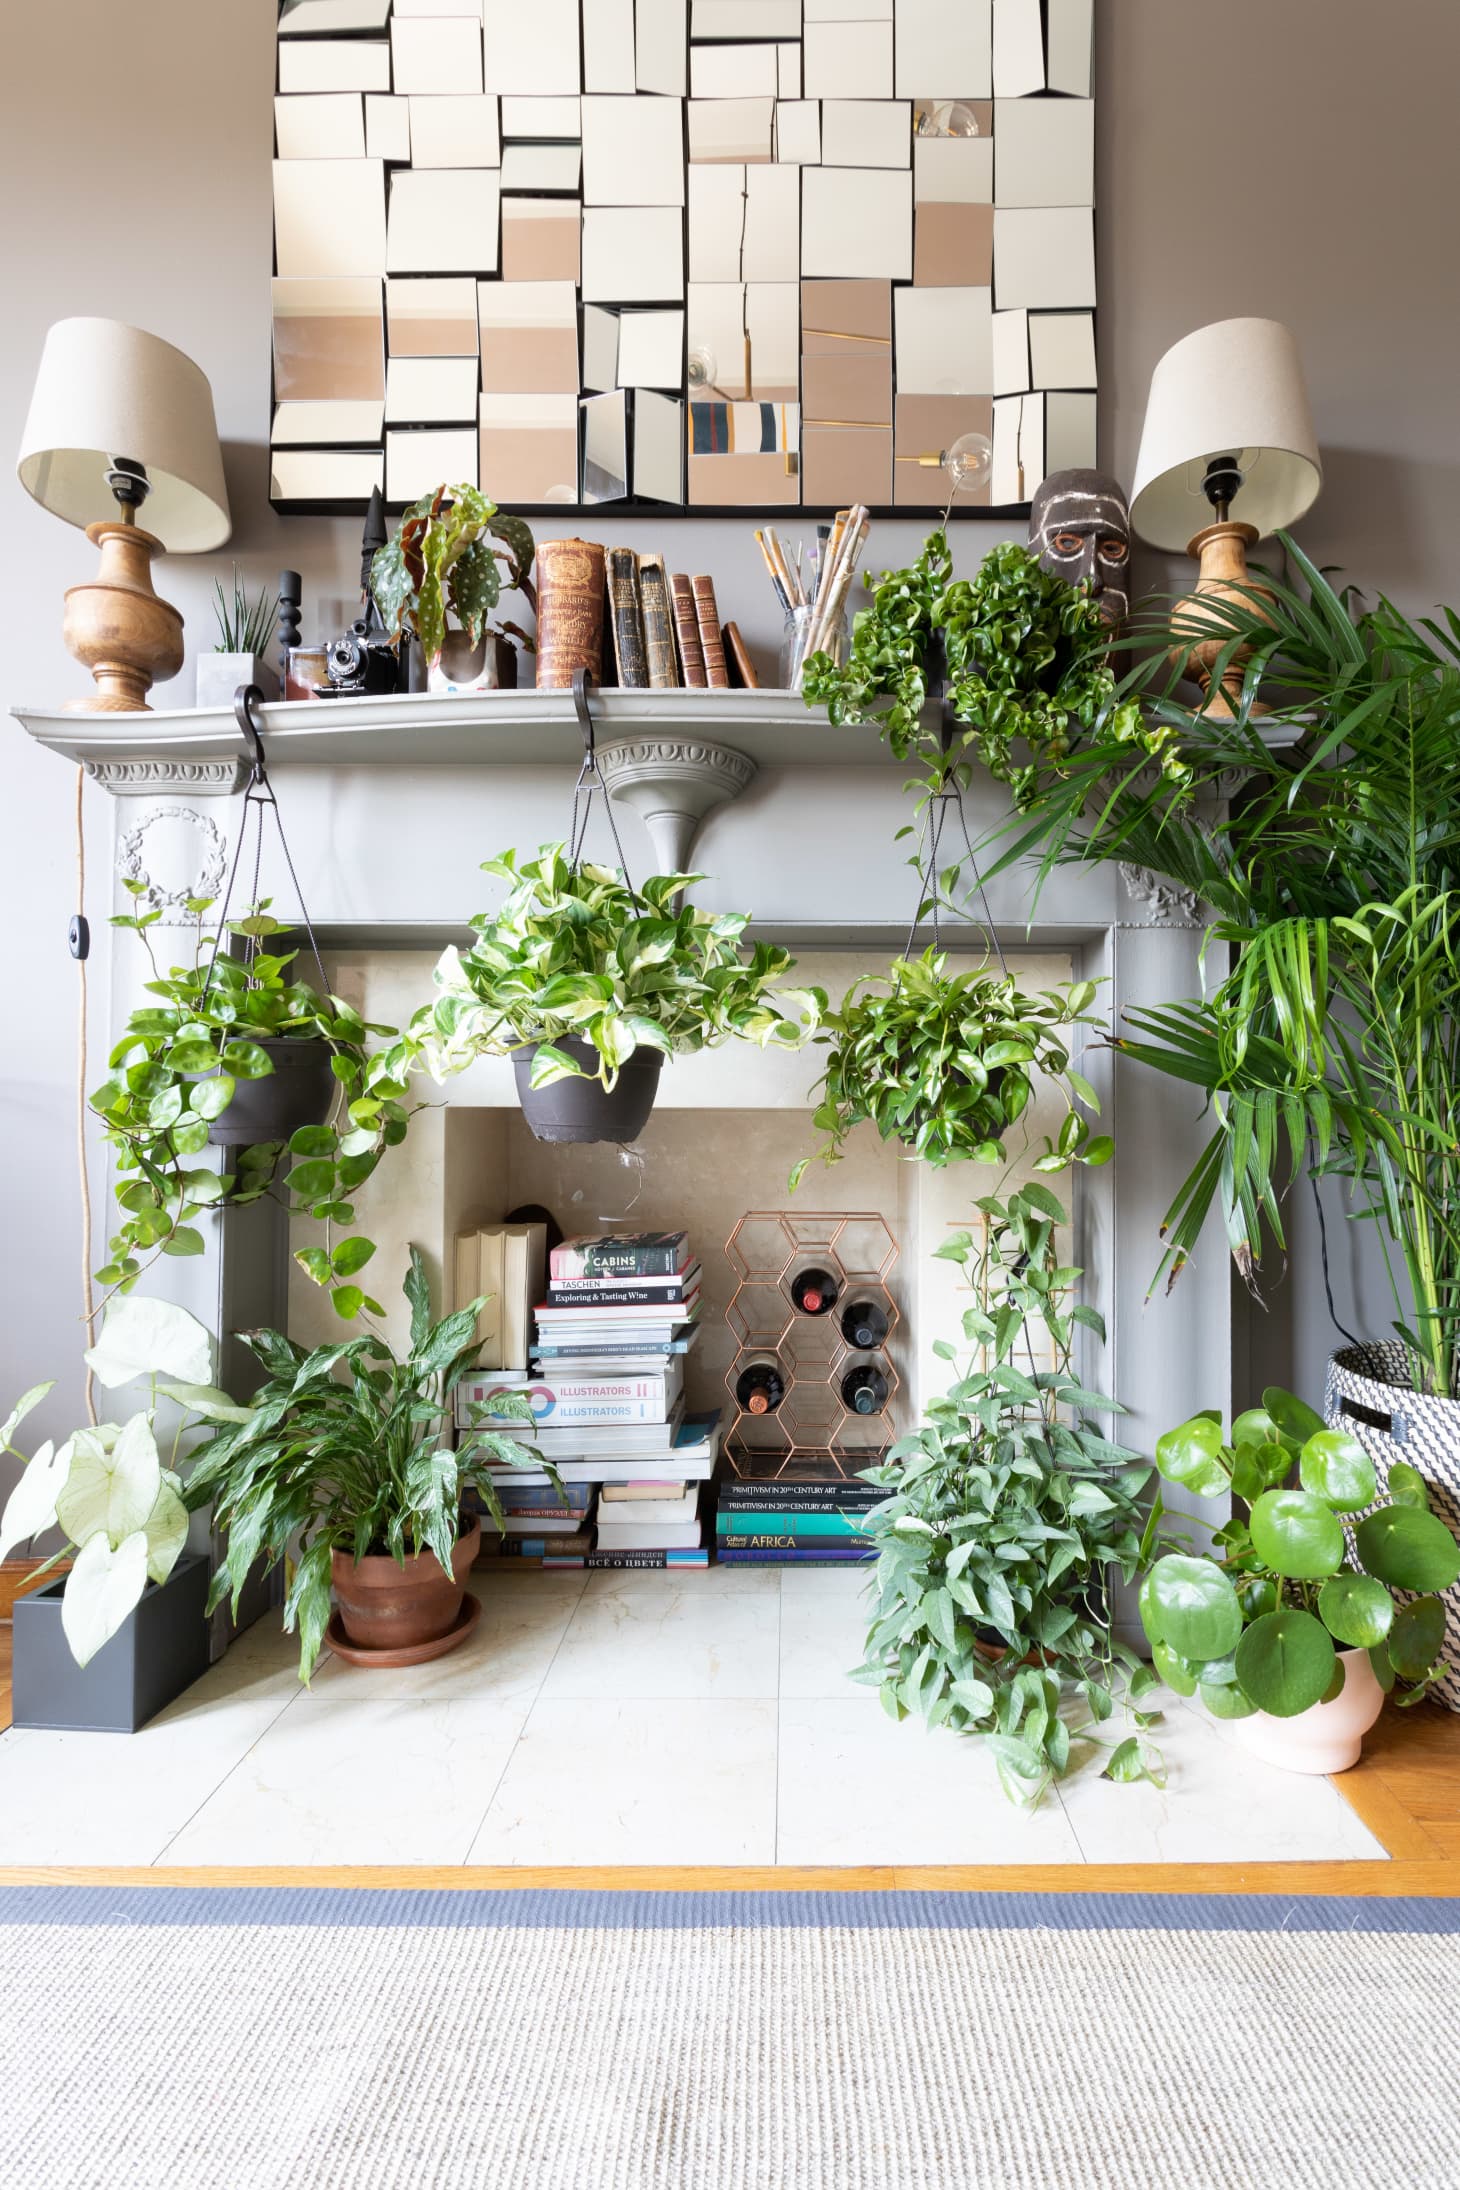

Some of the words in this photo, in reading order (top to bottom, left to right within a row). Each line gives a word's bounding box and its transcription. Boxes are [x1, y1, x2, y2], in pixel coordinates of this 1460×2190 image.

[593, 1256, 636, 1267] CABINS
[562, 1280, 601, 1289] TASCHEN
[555, 1294, 592, 1303] Exploring
[593, 1293, 600, 1301] &
[601, 1292, 627, 1302] Tasting
[560, 1386, 632, 1397] ILLUSTRATORS
[560, 1407, 632, 1417] ILLUSTRATORS
[794, 1486, 824, 1494] CENTURY
[751, 1535, 796, 1548] AFRICA
[588, 1558, 610, 1567] ВСЁ
[625, 1559, 663, 1568] ЦВЕТЕ
